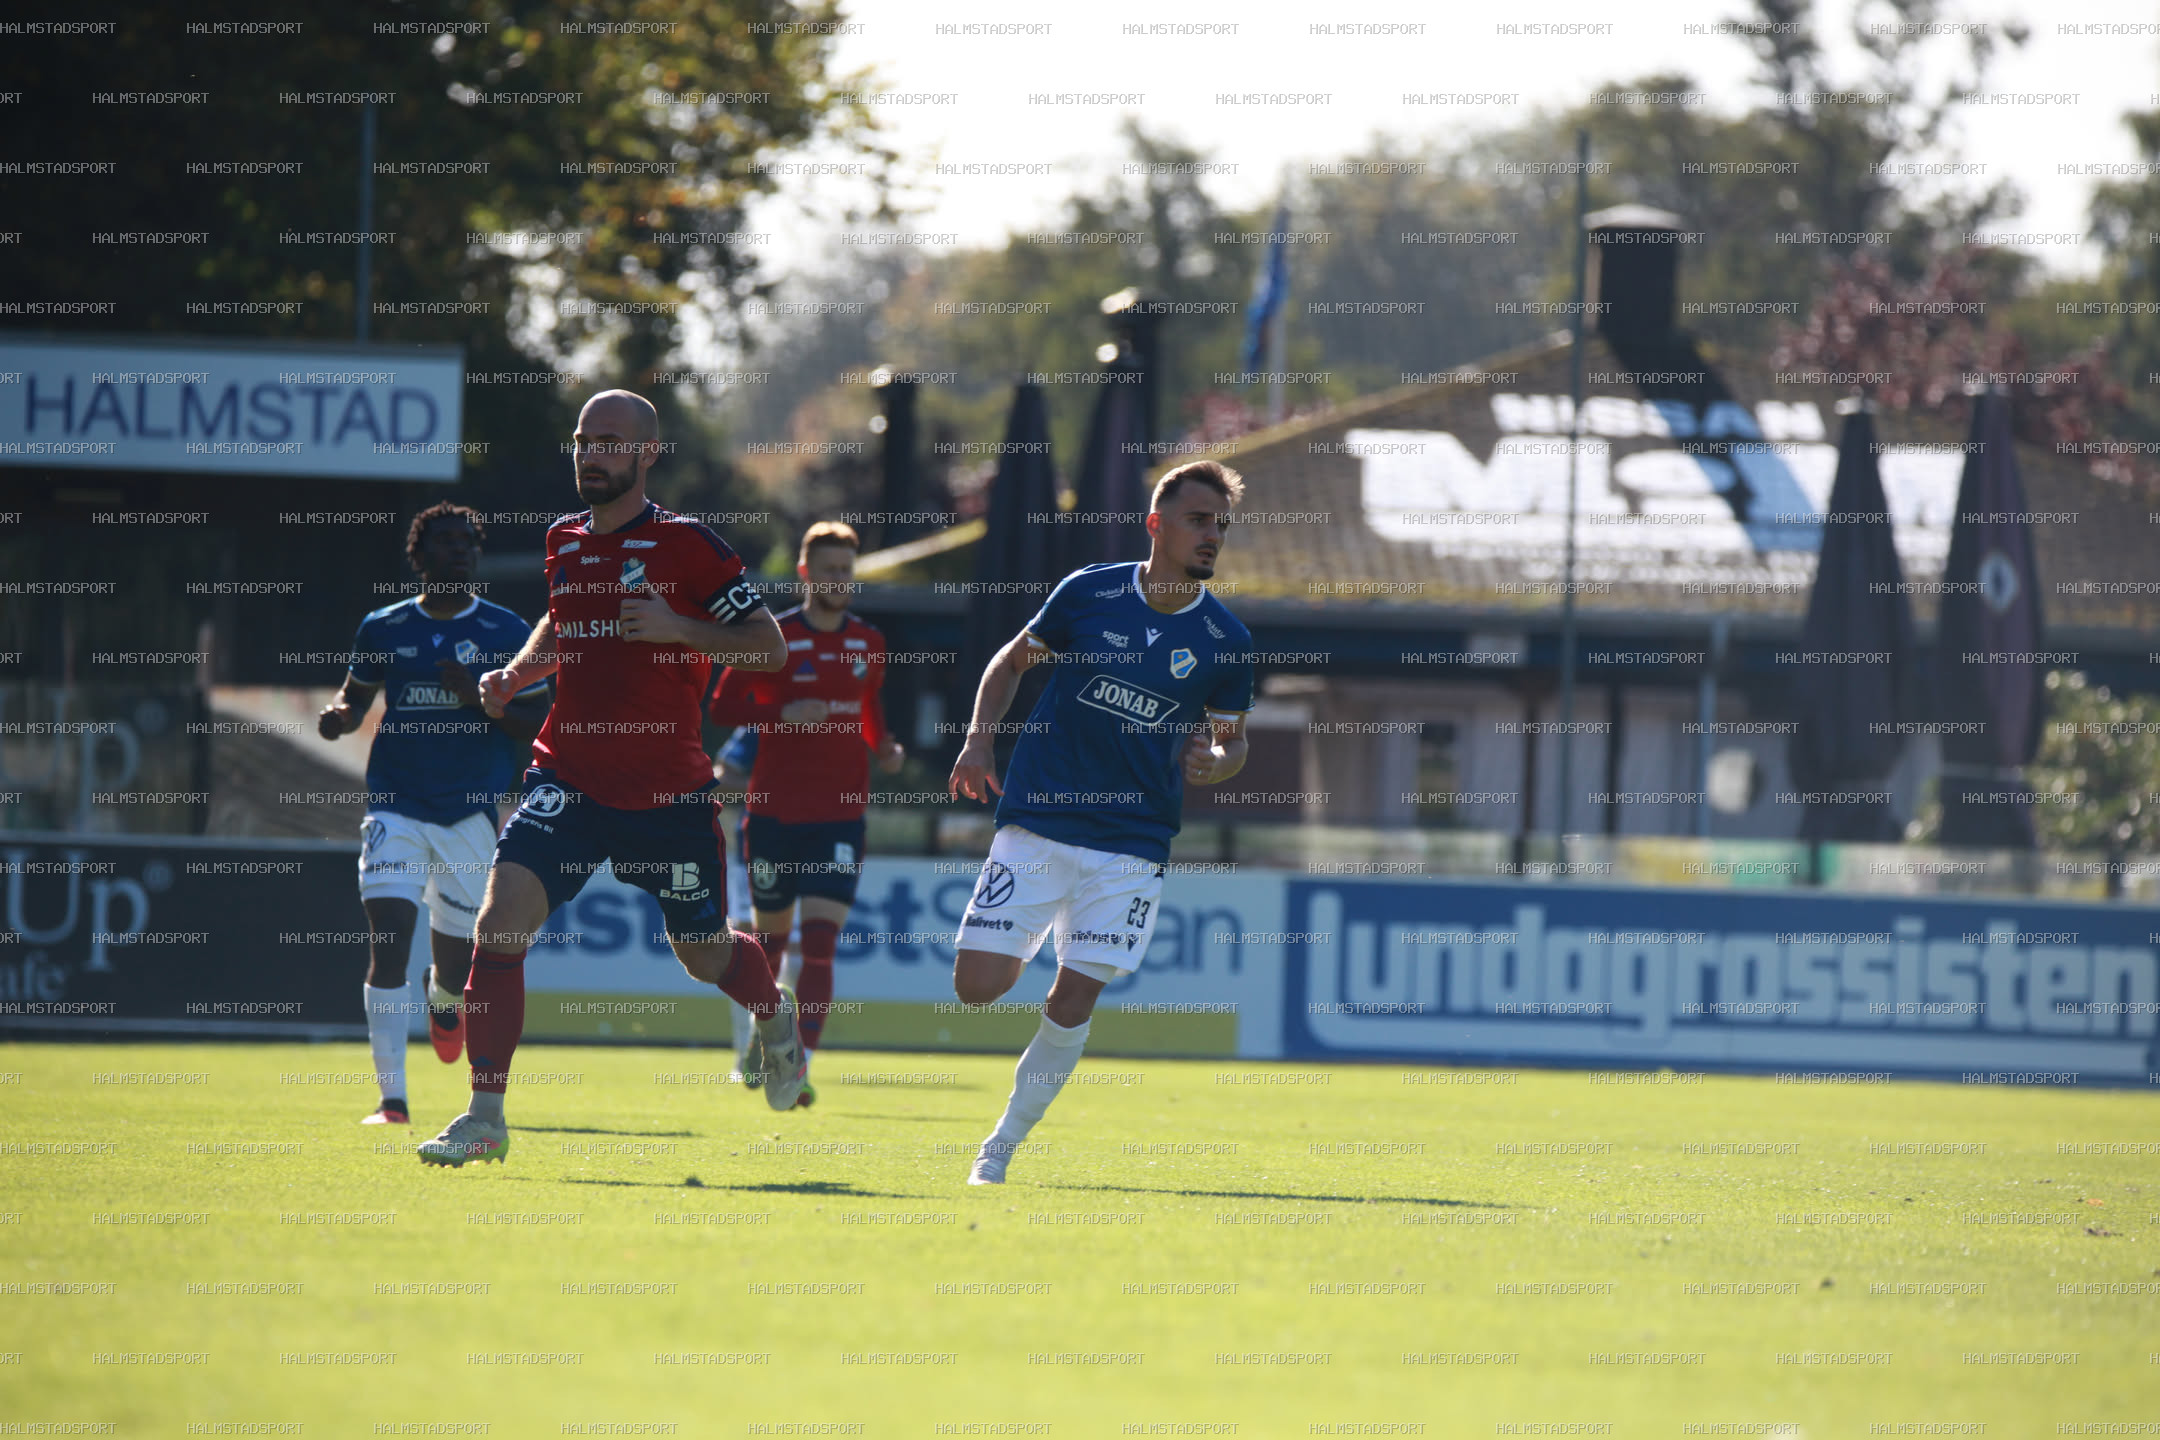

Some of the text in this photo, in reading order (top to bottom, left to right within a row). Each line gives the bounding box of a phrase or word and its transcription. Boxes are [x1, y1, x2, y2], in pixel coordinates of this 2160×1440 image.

[24, 373, 440, 447] HALMSTAD
[1102, 630, 1129, 645] sport
[1093, 680, 1160, 718] JONAB
[659, 888, 710, 902] BALCO
[1127, 896, 1151, 929] 23
